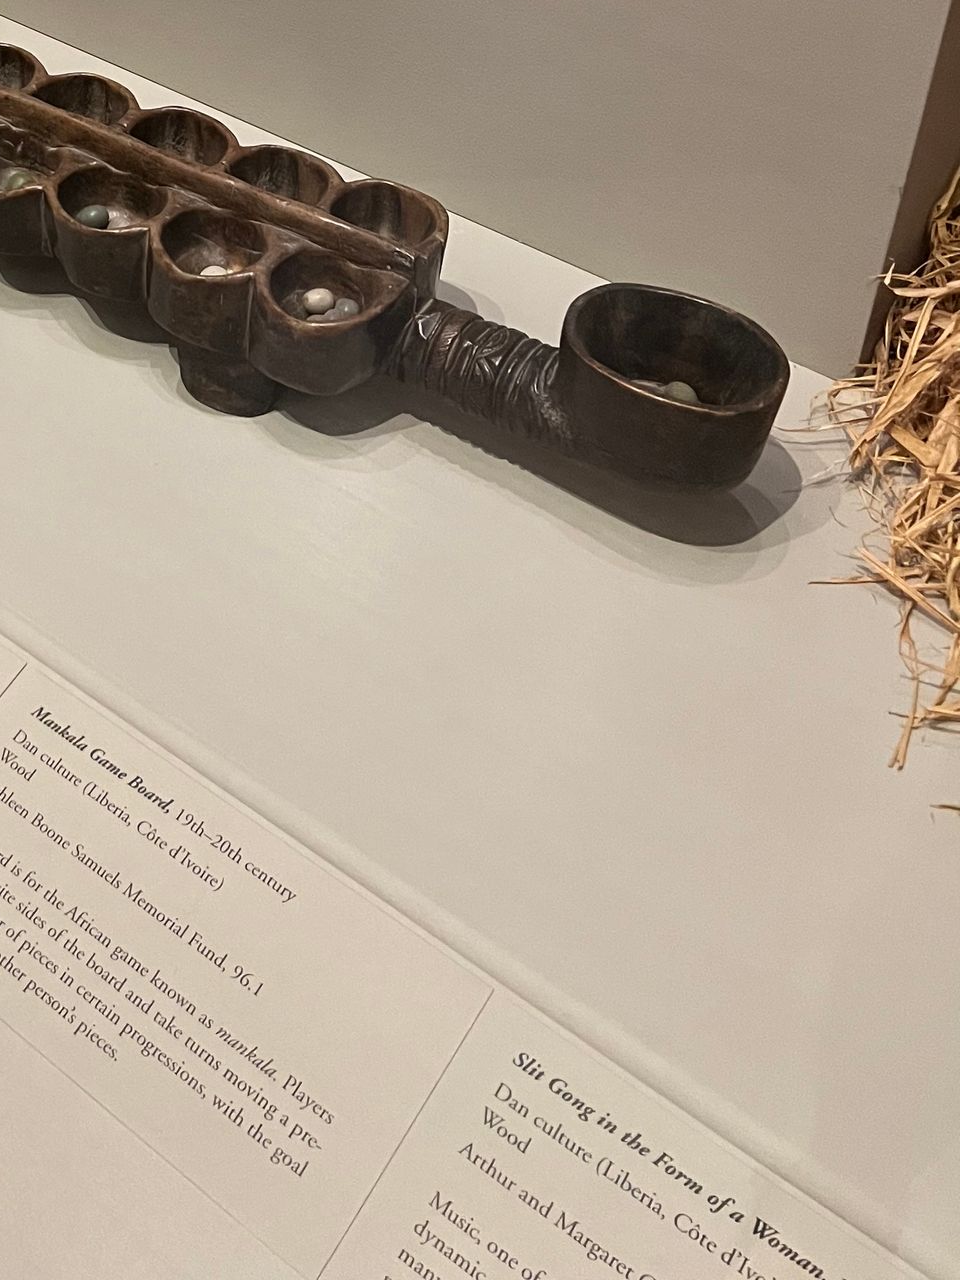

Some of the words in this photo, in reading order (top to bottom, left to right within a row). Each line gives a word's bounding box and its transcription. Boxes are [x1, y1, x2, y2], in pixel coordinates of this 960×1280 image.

[0, 746, 37, 782] Wood
[11, 728, 39, 756] Dan
[38, 752, 82, 787] culture
[81, 780, 131, 827] (Liberia,
[136, 819, 168, 850] Côte
[29, 705, 88, 752] Mankala
[88, 747, 128, 780] Game
[125, 774, 175, 814] Board,
[243, 861, 297, 903] century
[29, 811, 71, 850] Boone
[69, 843, 122, 889] Samuels
[121, 881, 190, 939] Memorial
[186, 930, 228, 973] Fund,
[229, 964, 264, 997] 96.1
[4, 927, 27, 943] of
[16, 939, 59, 975] pieces
[58, 966, 74, 988] in
[75, 984, 121, 1026] certain
[117, 1022, 206, 1100] progressions,
[211, 1093, 244, 1127] with
[246, 1122, 272, 1149] the
[268, 1146, 309, 1178] goal
[9, 860, 23, 877] is
[21, 870, 43, 892] for
[42, 887, 65, 910] the
[62, 905, 111, 949] African
[108, 945, 149, 977] game
[148, 968, 197, 1016] known
[197, 1013, 214, 1029] as
[214, 1026, 277, 1082] mankala.
[281, 1073, 335, 1125] Players
[14, 900, 47, 930] sides
[46, 926, 69, 942] of
[62, 937, 85, 961] the
[84, 951, 128, 993] board
[123, 989, 155, 1015] and
[152, 1010, 183, 1040] take
[183, 1035, 222, 1071] turns
[221, 1067, 279, 1121] moving
[278, 1113, 289, 1127] a
[286, 1122, 322, 1150] pre-
[72, 1020, 118, 1062] pieces.
[456, 1141, 517, 1191] Arthur
[517, 1189, 554, 1219] and
[552, 1209, 634, 1279] Margaret
[482, 1105, 532, 1154] Wood
[492, 1081, 529, 1118] Dan
[532, 1116, 593, 1164] culture
[595, 1156, 665, 1220] (Liberia,
[673, 1212, 718, 1254] Côte
[511, 1051, 545, 1081] Slit
[547, 1077, 596, 1122] Gong
[595, 1111, 618, 1134] in
[619, 1131, 651, 1157] the
[650, 1150, 703, 1195] Form
[706, 1194, 736, 1214] of
[727, 1210, 745, 1223] a
[427, 1189, 481, 1246] Music,
[485, 1240, 519, 1270] one
